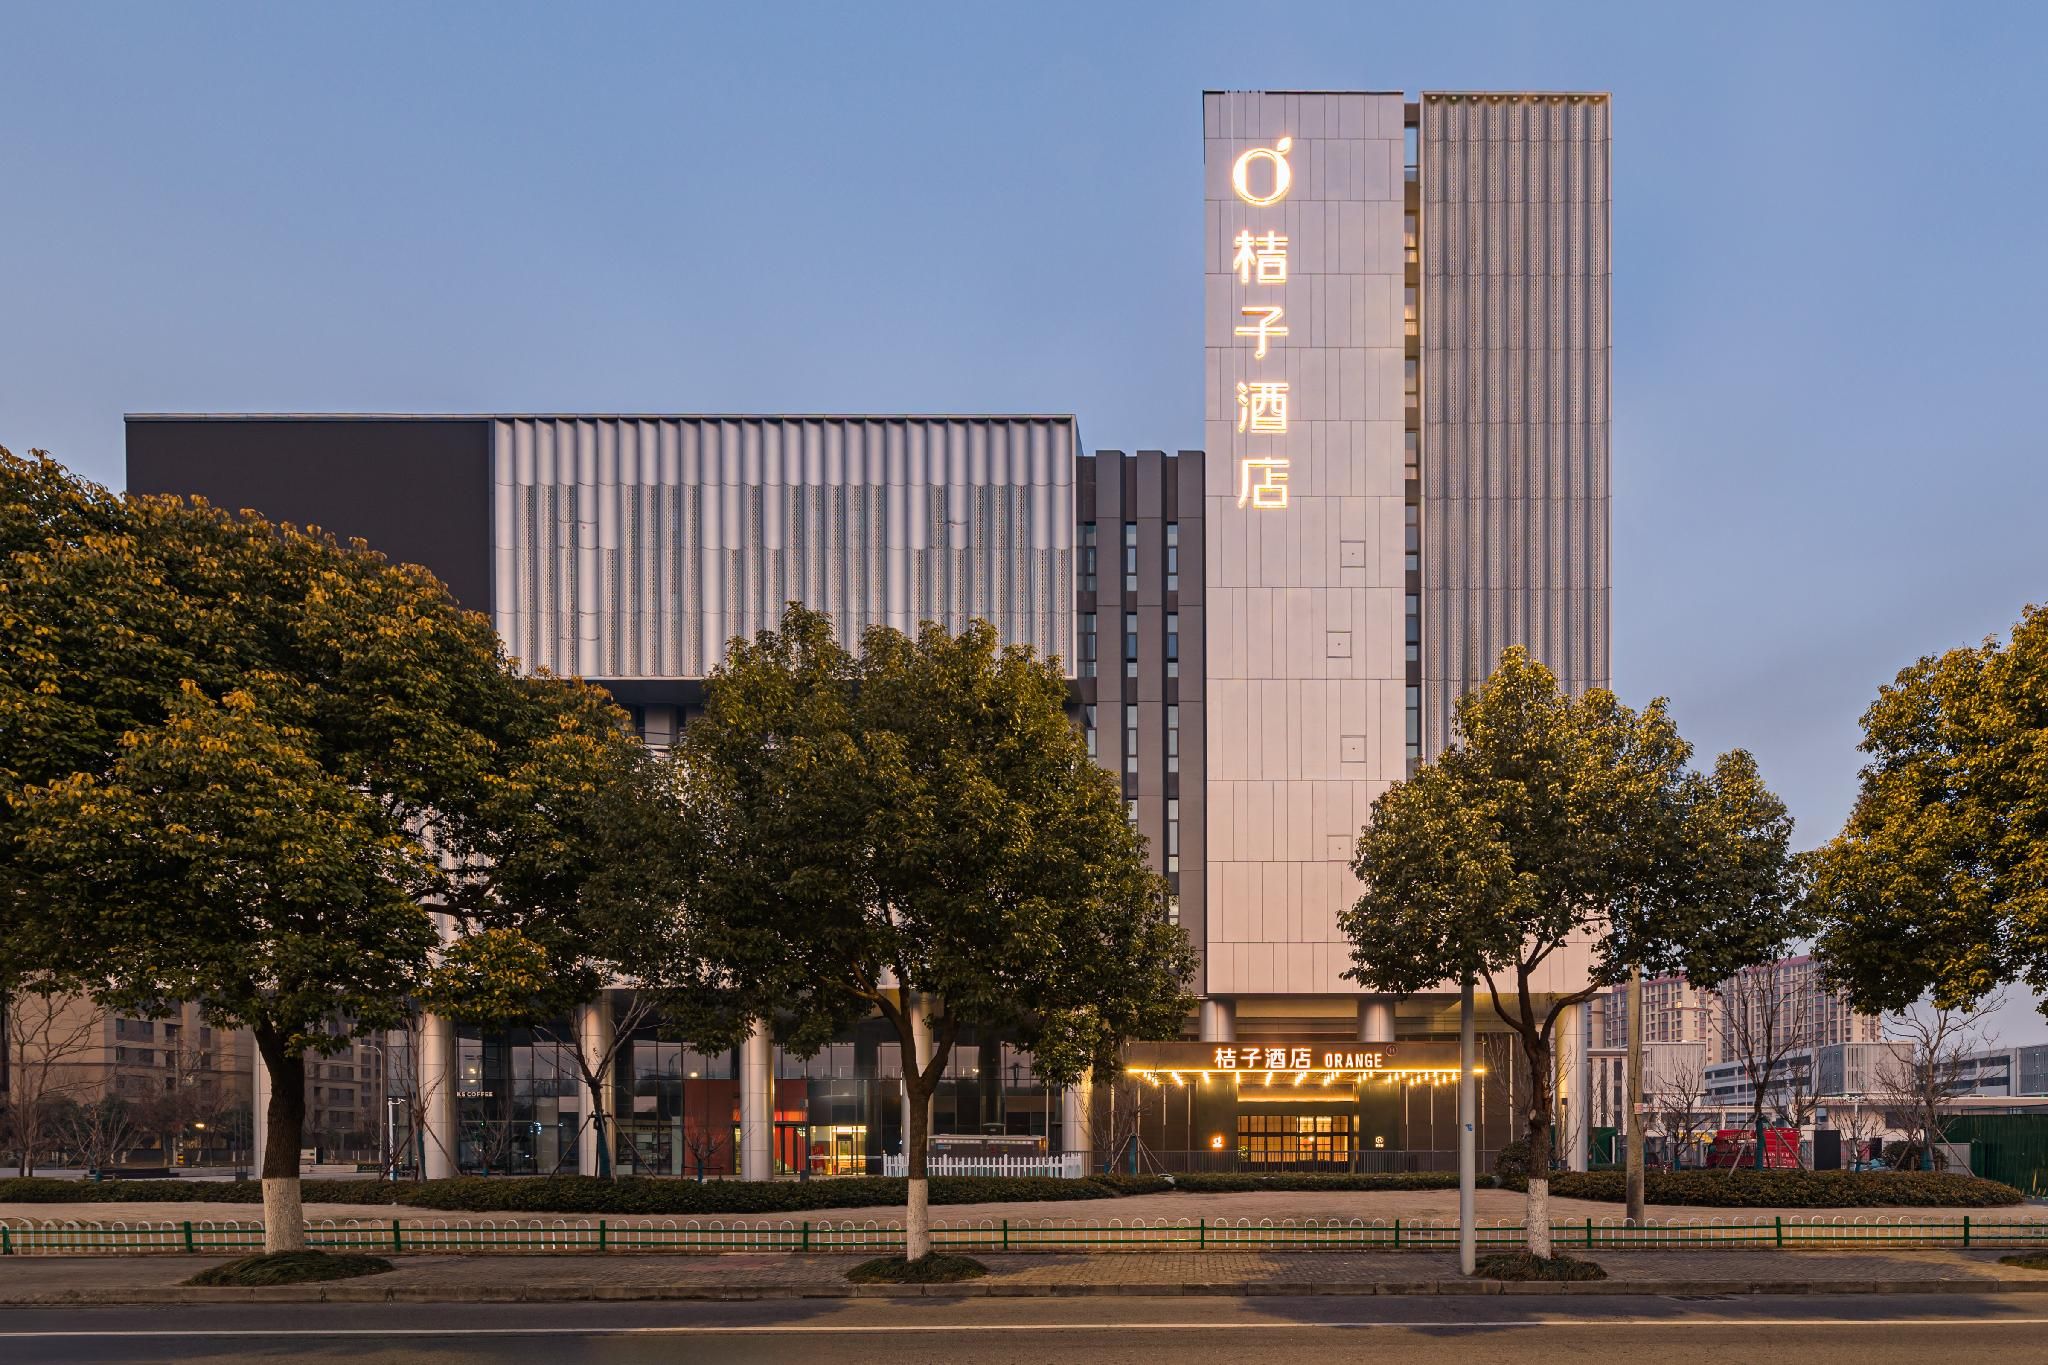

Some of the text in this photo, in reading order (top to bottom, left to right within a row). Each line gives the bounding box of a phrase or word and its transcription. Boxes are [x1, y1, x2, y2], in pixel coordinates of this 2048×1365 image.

[1233, 230, 1290, 509] 桔子酒店
[1215, 1047, 1382, 1069] 桔子酒店 ORANGE
